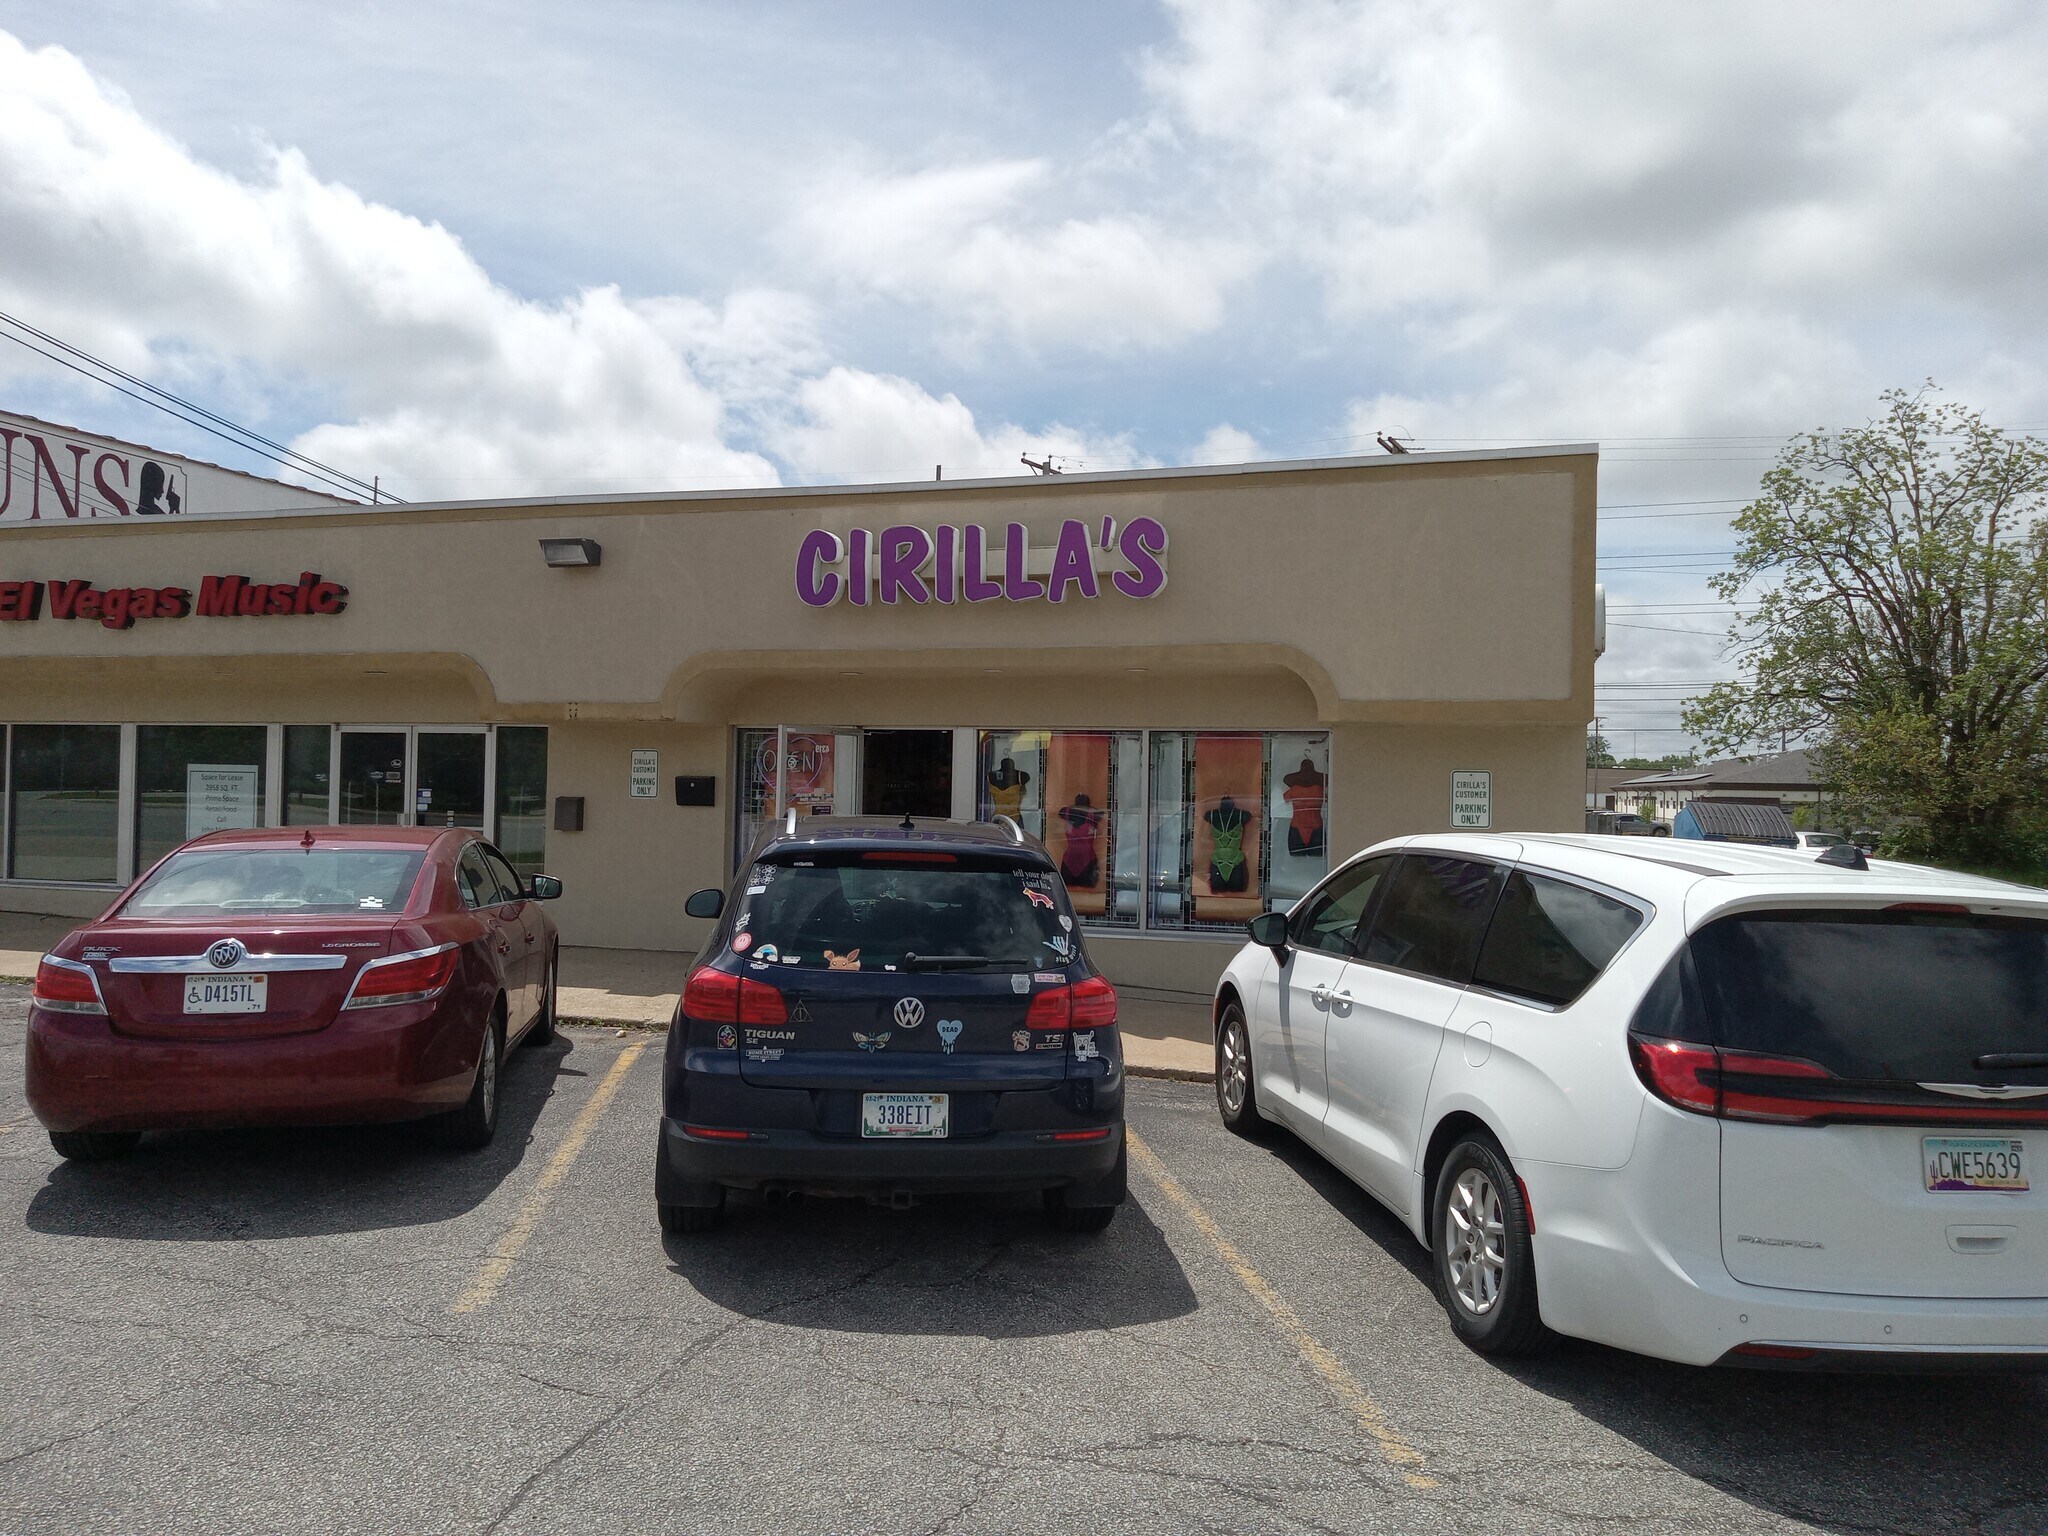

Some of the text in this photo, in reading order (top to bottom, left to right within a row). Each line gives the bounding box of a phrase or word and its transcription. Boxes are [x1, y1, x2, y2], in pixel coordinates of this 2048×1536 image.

[795, 515, 1169, 608] CIRILLA'S
[48, 579, 192, 629] Vegas
[196, 571, 349, 617] Music
[763, 750, 815, 772] OEN
[632, 777, 655, 786] PARKING
[1456, 781, 1487, 789] CIRILLA'S
[636, 786, 651, 795] ONLY
[1455, 790, 1487, 799] CUSTOMER
[222, 795, 240, 803] Space
[1454, 803, 1487, 813] PARKING
[1460, 814, 1481, 825] ONLY
[1012, 868, 1053, 883] tell your dog
[1027, 878, 1040, 889] said
[204, 984, 255, 1003] D415TL
[744, 1028, 796, 1040] TIGUAN
[878, 1105, 932, 1125] 338EIT
[933, 1128, 943, 1136] 71
[1938, 1151, 2021, 1179] CWE5639
[1737, 1234, 1825, 1250] PACIFICA
